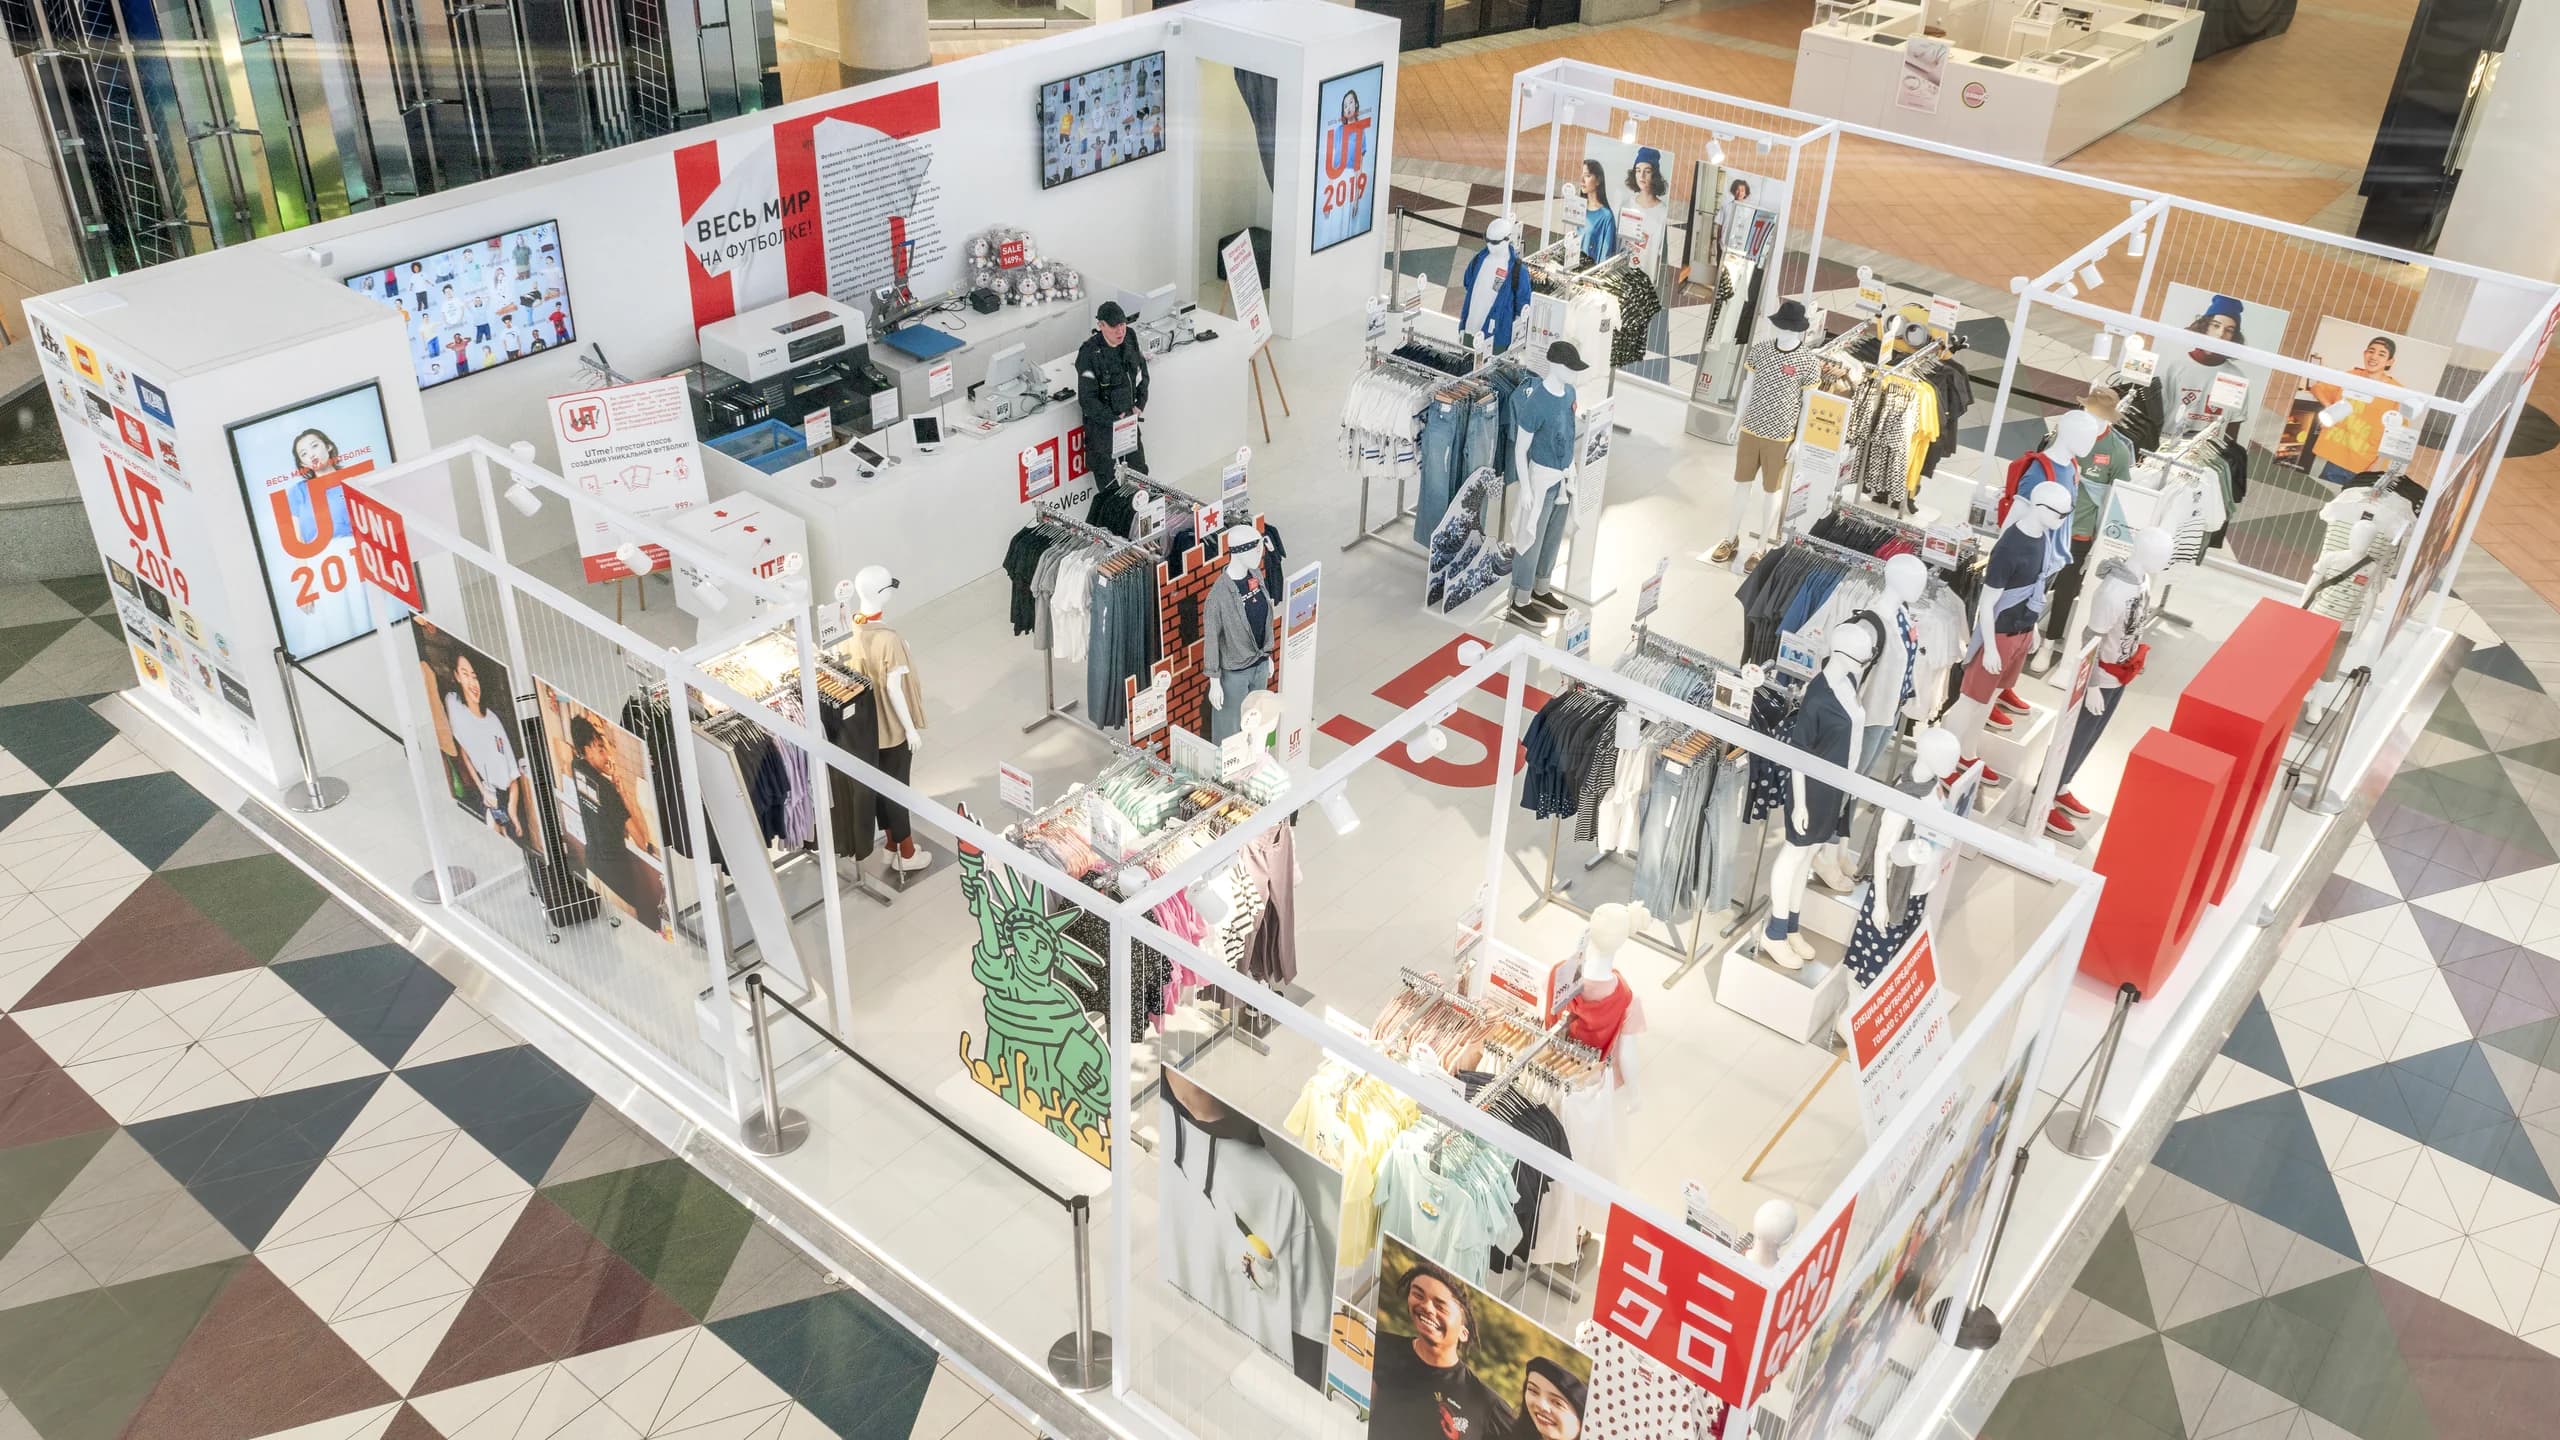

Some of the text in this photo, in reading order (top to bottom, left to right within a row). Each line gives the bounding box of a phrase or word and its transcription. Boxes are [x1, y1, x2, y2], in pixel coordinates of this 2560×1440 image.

[1325, 117, 1371, 180] UT
[697, 190, 811, 242] ВЕСЬ МИР
[1322, 173, 1367, 213] 2019
[700, 220, 813, 268] НА ФУТБОЛКЕ!
[1002, 243, 1022, 255] SALE
[571, 455, 608, 469] СОЗДАНИЯ
[585, 447, 614, 458] UTme!
[104, 454, 171, 560] UT
[266, 474, 289, 487] ВЕСЬ
[351, 499, 398, 553] UNI
[129, 538, 189, 606] 2019
[290, 547, 366, 607] 201
[360, 541, 410, 593] QLO
[1853, 981, 1895, 1032] СПЕЦИАЛЬНОЕ
[1872, 1016, 1894, 1048] ТОЛЬКО
[1893, 1011, 1898, 1024] С
[1902, 997, 1910, 1014] ПО
[1912, 978, 1924, 1001] МАЯ
[1874, 1011, 1884, 1029] НА
[1883, 977, 1911, 1019] ФУТБОЛКИ
[1622, 1234, 1736, 1334] ユニ
[1778, 1228, 1841, 1330] UNI
[1609, 1287, 1728, 1384] クロ
[1764, 1276, 1831, 1378] QLO
